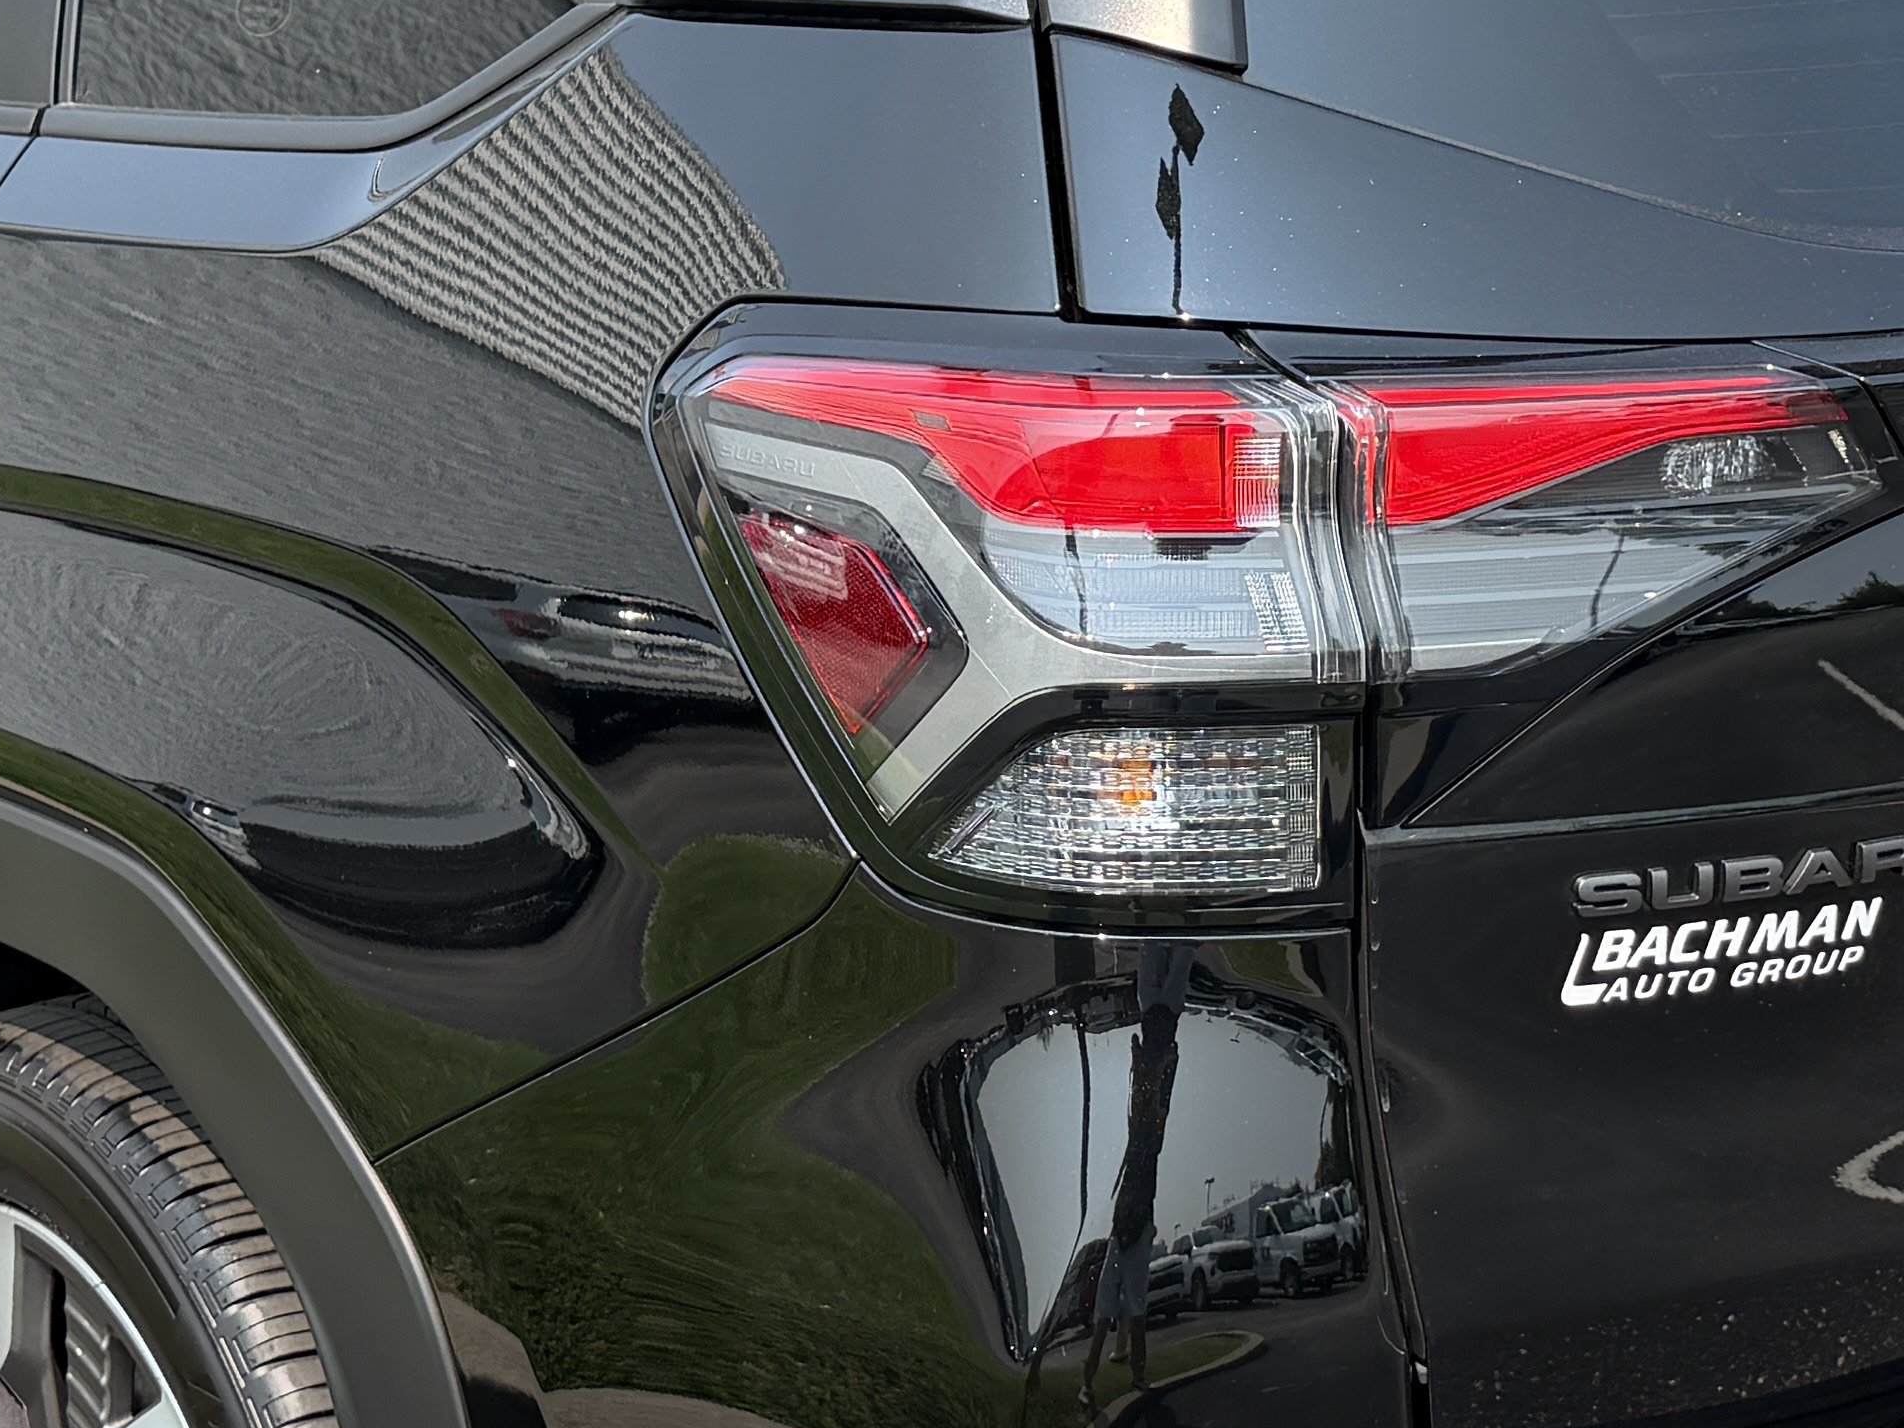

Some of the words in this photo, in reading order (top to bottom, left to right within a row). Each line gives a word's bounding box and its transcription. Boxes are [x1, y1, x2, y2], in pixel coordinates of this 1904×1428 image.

[719, 444, 816, 477] SUBARU
[1591, 895, 1884, 973] BACHMAN
[1602, 967, 1717, 1004] AUTO
[1728, 944, 1866, 990] GROUP
